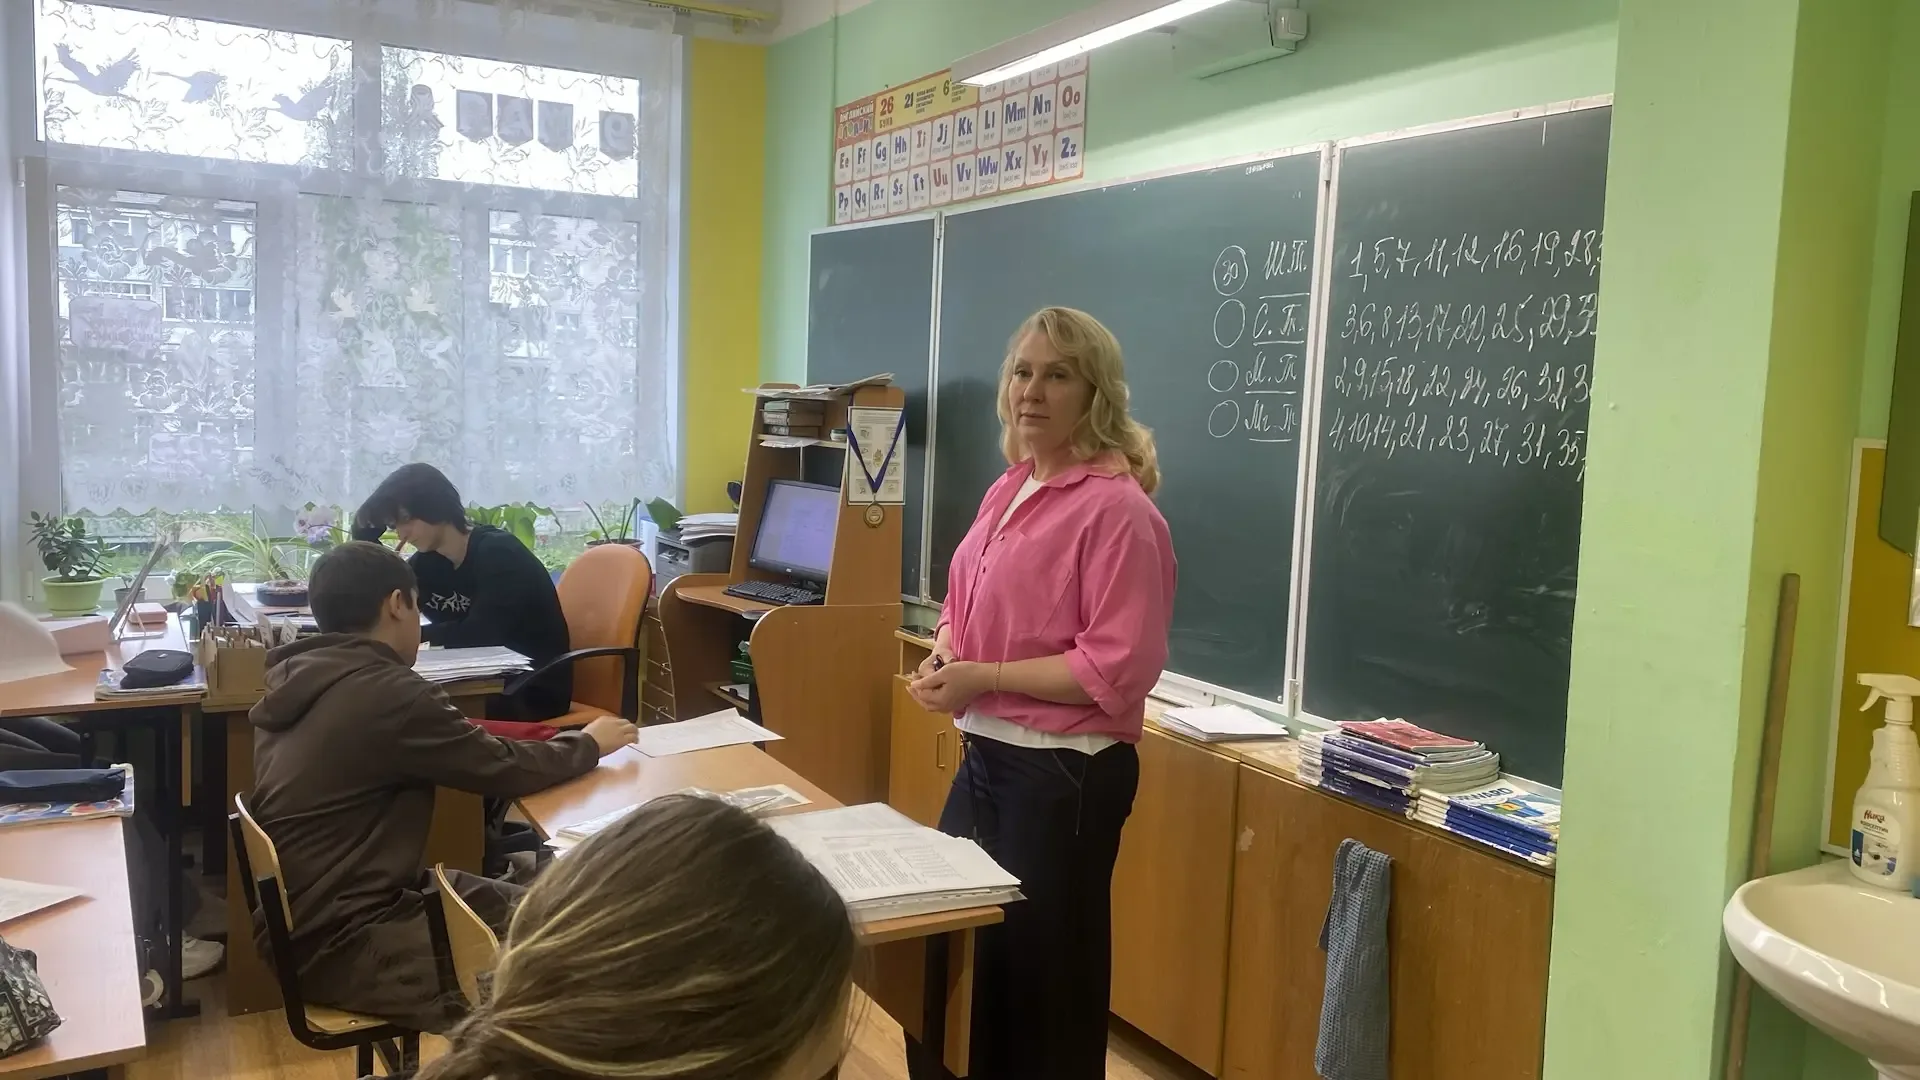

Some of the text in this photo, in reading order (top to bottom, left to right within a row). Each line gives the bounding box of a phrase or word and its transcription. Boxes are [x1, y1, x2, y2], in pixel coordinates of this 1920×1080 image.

[880, 96, 894, 116] 26
[904, 92, 914, 109] 21
[840, 153, 849, 169] Ee
[858, 148, 866, 164] Ff
[875, 142, 886, 161] Gg
[895, 136, 906, 154] Hh
[937, 124, 947, 144] Jj
[958, 117, 972, 137] Kk
[1005, 102, 1025, 124] Mm
[1033, 94, 1051, 116] Nn
[1062, 86, 1080, 107] Oo
[839, 192, 848, 211] Pp
[855, 188, 866, 208] Qq
[874, 184, 884, 200] Rr
[893, 179, 903, 196] Ss
[913, 173, 924, 191] Tt
[933, 168, 948, 187] Uu
[957, 163, 971, 182] Vv
[979, 156, 998, 176] Ww
[1005, 150, 1021, 171] Xx
[1033, 144, 1048, 168] Yy
[1061, 137, 1076, 159] Zz
